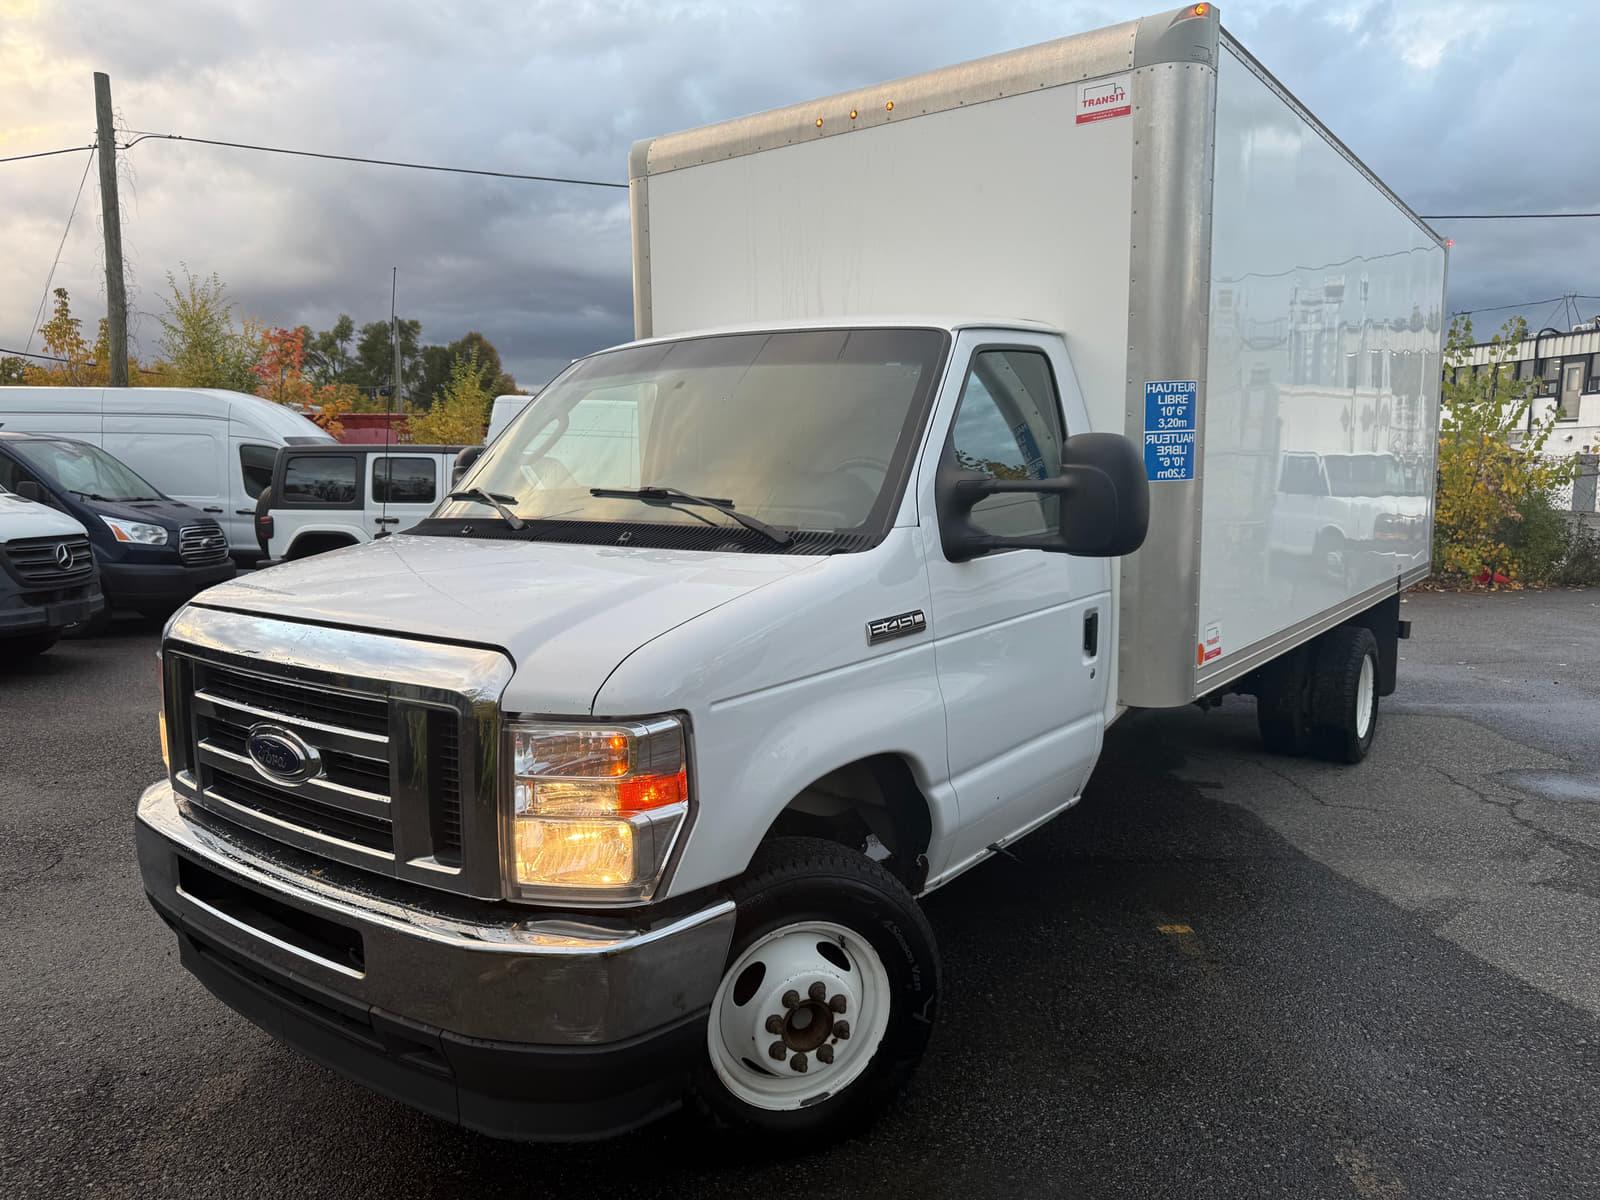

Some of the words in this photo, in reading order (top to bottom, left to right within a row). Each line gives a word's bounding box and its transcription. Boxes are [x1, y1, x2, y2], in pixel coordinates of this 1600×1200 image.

[1082, 92, 1126, 108] TRANSIT
[1147, 382, 1196, 394] HAUTEUR
[1158, 394, 1189, 405] LIBRE
[1161, 406, 1175, 416] 10'
[1176, 406, 1187, 416] 6"
[1158, 418, 1188, 429] 3,20m
[868, 613, 924, 637] E-450
